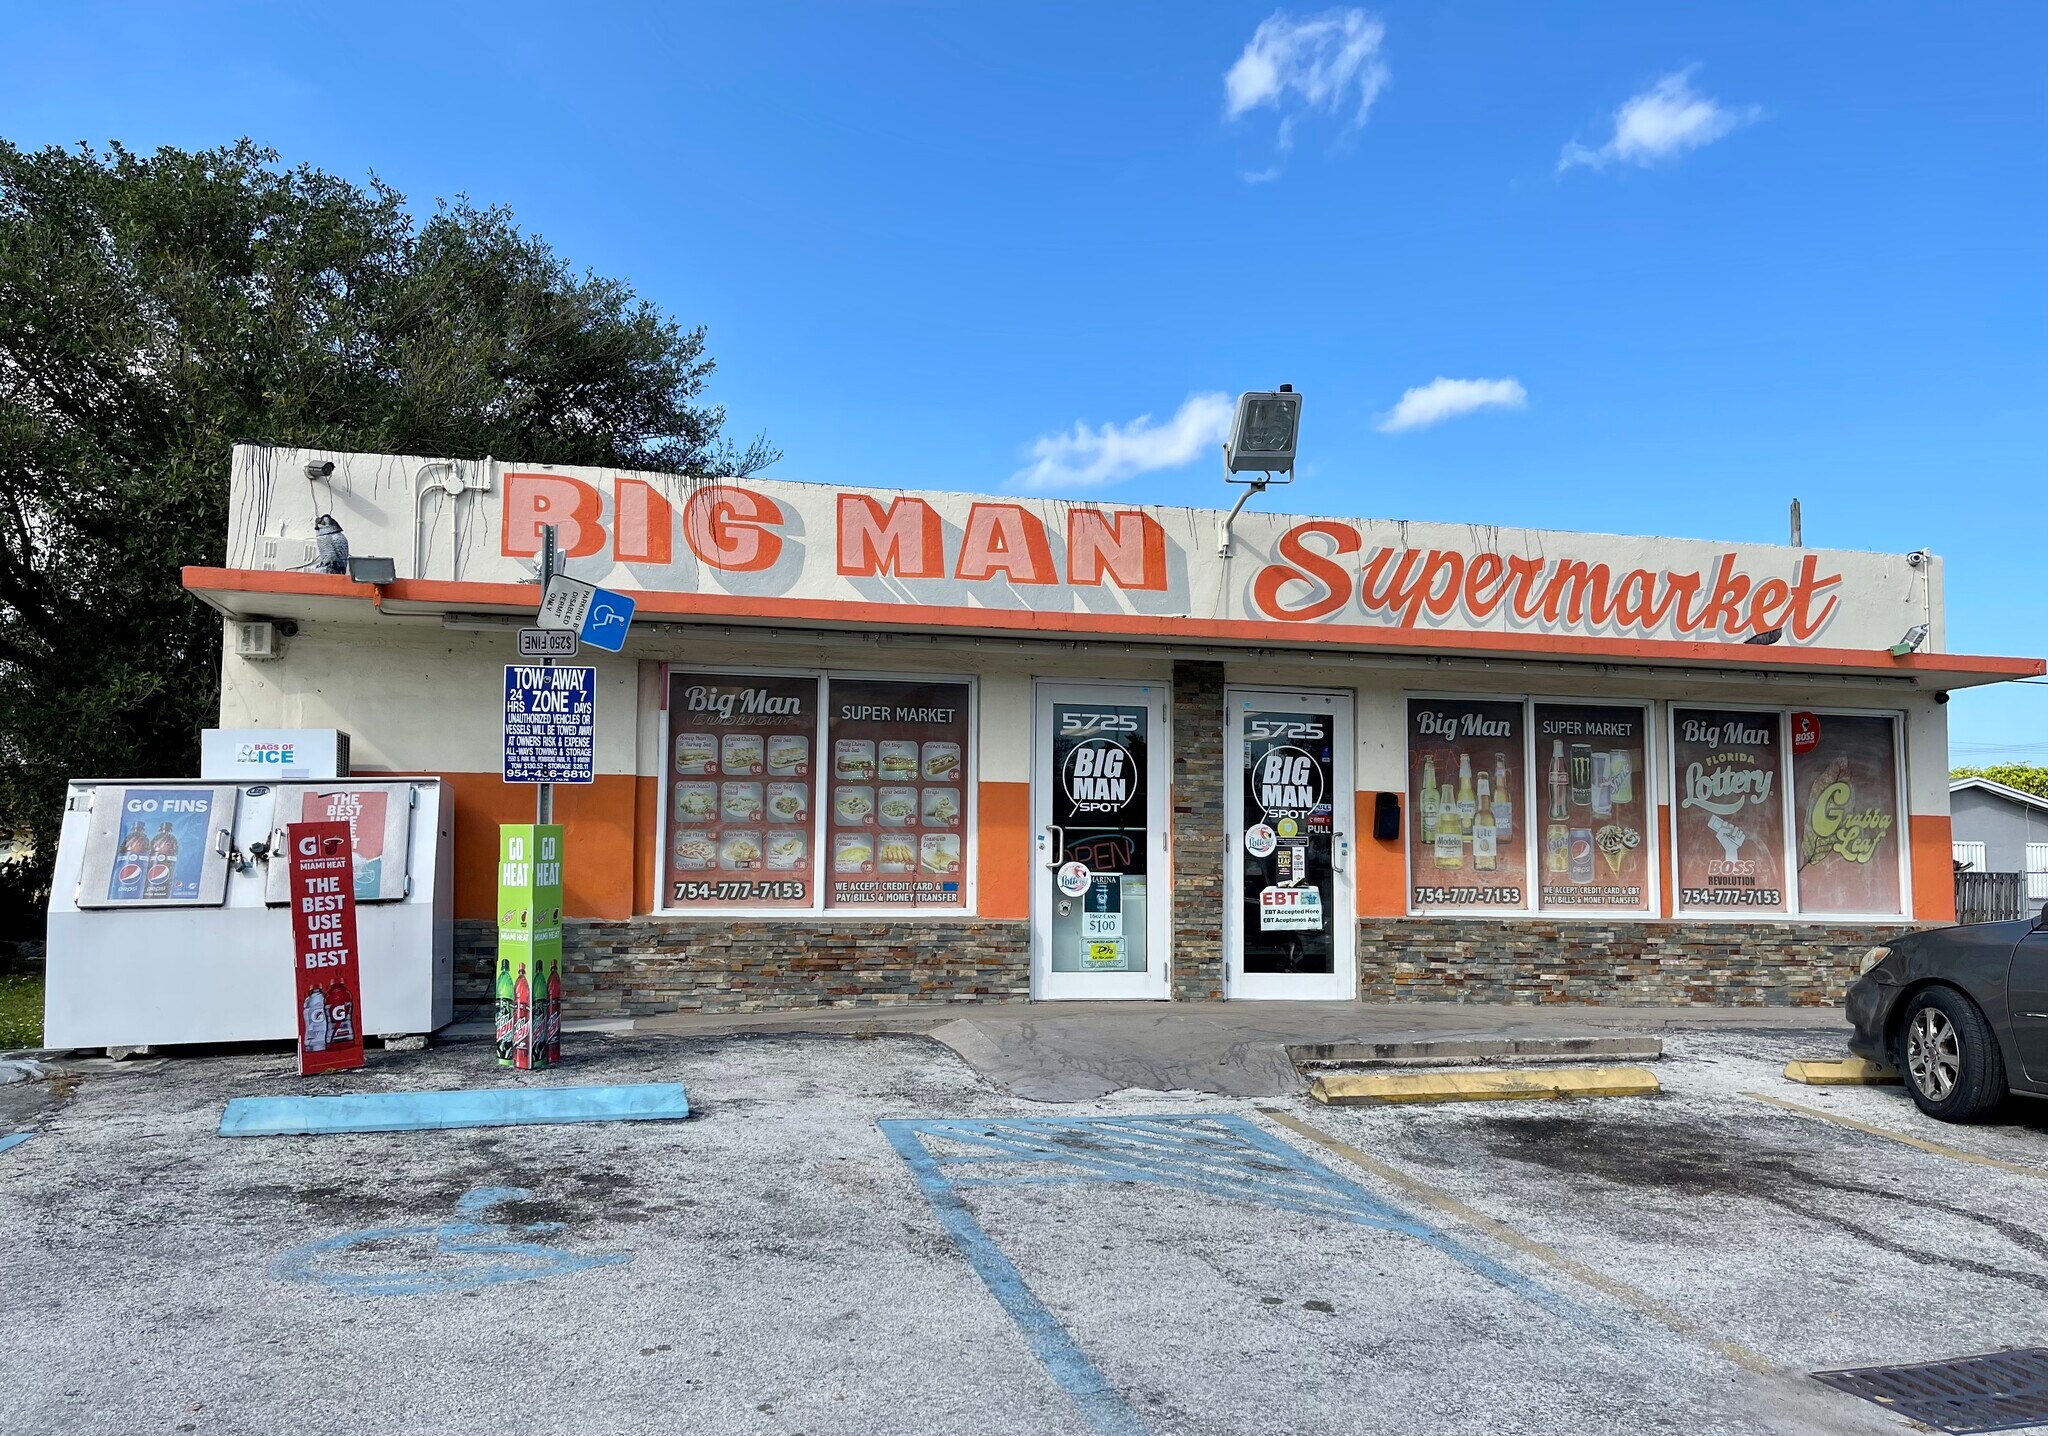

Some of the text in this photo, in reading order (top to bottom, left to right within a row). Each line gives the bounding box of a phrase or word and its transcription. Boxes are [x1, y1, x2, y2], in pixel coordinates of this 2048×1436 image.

[501, 472, 1842, 640] BIG MAN Supermarket
[546, 592, 557, 612] ONLY
[555, 592, 568, 618] PERMIT
[563, 591, 579, 625] DISABLED
[575, 590, 590, 621] PARKING
[525, 636, 572, 650] $250 FINE
[514, 667, 586, 690] TOW AWAY
[510, 689, 523, 700] 24
[531, 690, 569, 712] ZONE
[579, 690, 587, 702] 7
[507, 701, 525, 713] HRS
[574, 702, 592, 714] DAYS
[685, 686, 801, 719] Big Man
[508, 713, 591, 725] UNAUTHORIZED VEHICLES OR
[841, 705, 955, 723] SUPER MARKET
[1063, 713, 1138, 731] 5725
[1416, 711, 1511, 741] Big Man
[1543, 720, 1632, 736] SUPER MARKET
[506, 724, 593, 736] VESSELS WILL BE TOWED AWAY
[1251, 720, 1324, 740] 5725
[1682, 719, 1770, 749] Big Man
[1796, 731, 1815, 742] BOSS
[254, 743, 294, 751] BAGS OF
[508, 736, 590, 747] AT OWNERS RISK & EXPENSE
[258, 751, 294, 763] ICE
[506, 747, 592, 756] ALL-WAYS TOWING & STORAGE
[1074, 748, 1124, 778] BIG
[1705, 753, 1755, 767] FLORIDA
[1262, 755, 1311, 785] BIG
[1073, 778, 1126, 801] MAN
[1681, 761, 1774, 815] Lottery
[331, 794, 360, 805] THE
[1262, 784, 1313, 808] MAN
[68, 797, 75, 811] 1
[127, 799, 208, 812] GO FINS
[327, 805, 363, 816] BEST
[1079, 802, 1121, 813] SPOT
[1812, 781, 1893, 838] Grabba
[1268, 809, 1309, 819] SPOT
[1307, 825, 1331, 834] PULL
[299, 837, 317, 856] G
[509, 837, 523, 860] GO
[541, 837, 555, 860] GO
[1833, 826, 1887, 864] Leaf
[300, 861, 346, 871] MIAMI HEAT
[1708, 860, 1755, 875] BOSS
[502, 863, 529, 887] HEAT
[536, 862, 560, 887] HEAT
[1708, 876, 1756, 886] REVOLUTION
[305, 877, 340, 894] THE
[675, 881, 805, 899] 754-777-7153
[835, 882, 941, 891] WE ACCEPT CREDIT CARD &
[1543, 886, 1553, 894] WE
[836, 893, 957, 902] PAY BILLS & MONEY TRANSFER
[1263, 892, 1298, 905] EBT
[1416, 888, 1520, 903] 754-777-7153
[1544, 896, 1639, 904] PAY BILLS & MONEY TRANSFER
[1682, 889, 1781, 904] 754-777-7153
[302, 895, 345, 913] BEST
[308, 913, 342, 931] USE
[308, 932, 343, 950] THE
[500, 932, 529, 942] MIAMI HEAT
[534, 930, 560, 941] MIAMI HEAT
[305, 949, 348, 969] BEST
[332, 1005, 346, 1020] G
